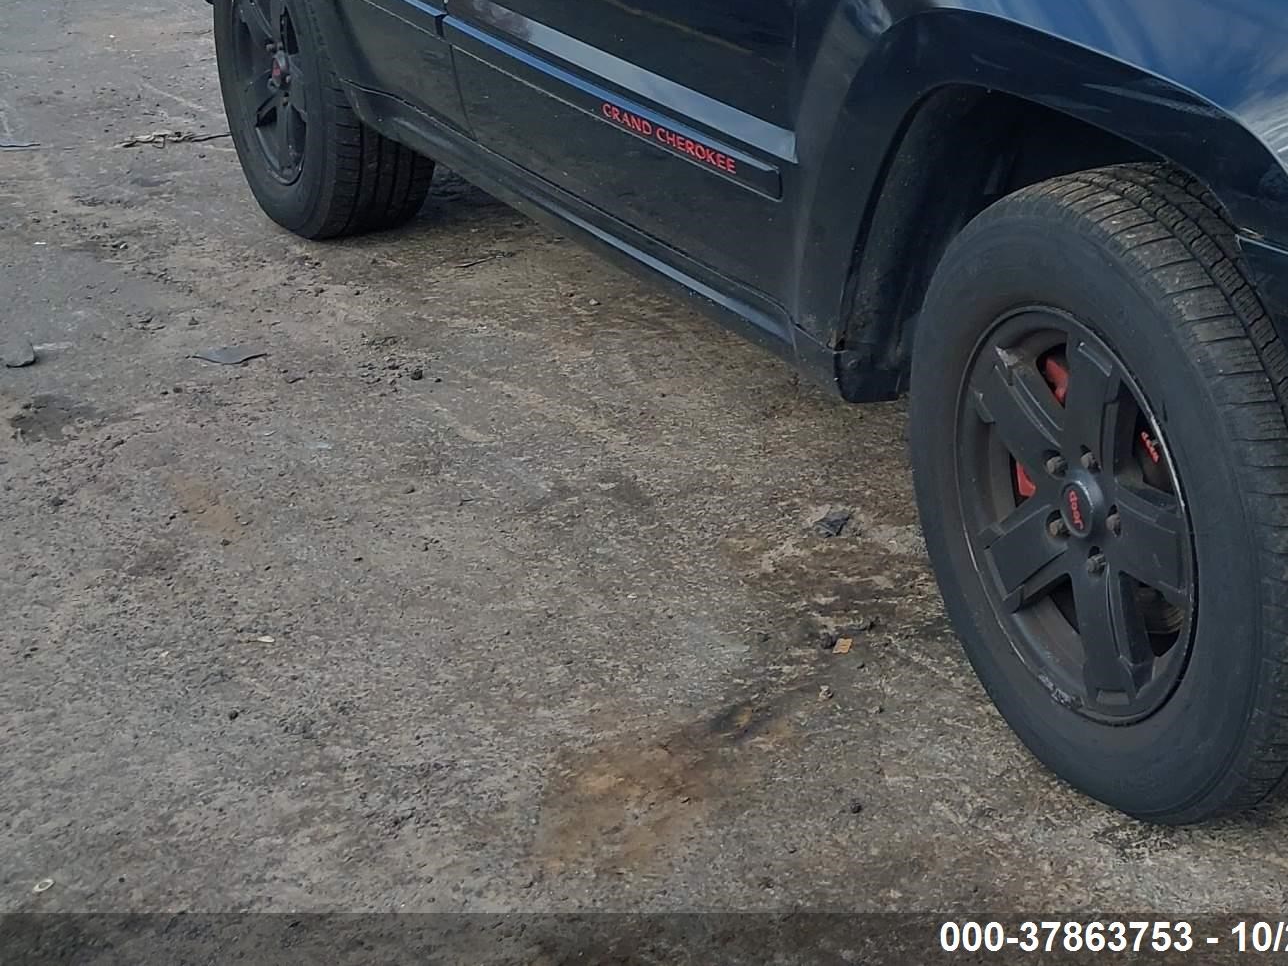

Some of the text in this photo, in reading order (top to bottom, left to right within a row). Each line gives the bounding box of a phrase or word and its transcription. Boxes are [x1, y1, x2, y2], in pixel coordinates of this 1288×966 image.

[602, 102, 737, 175] GRAND CHEROKEE
[1068, 490, 1085, 530] Jeep
